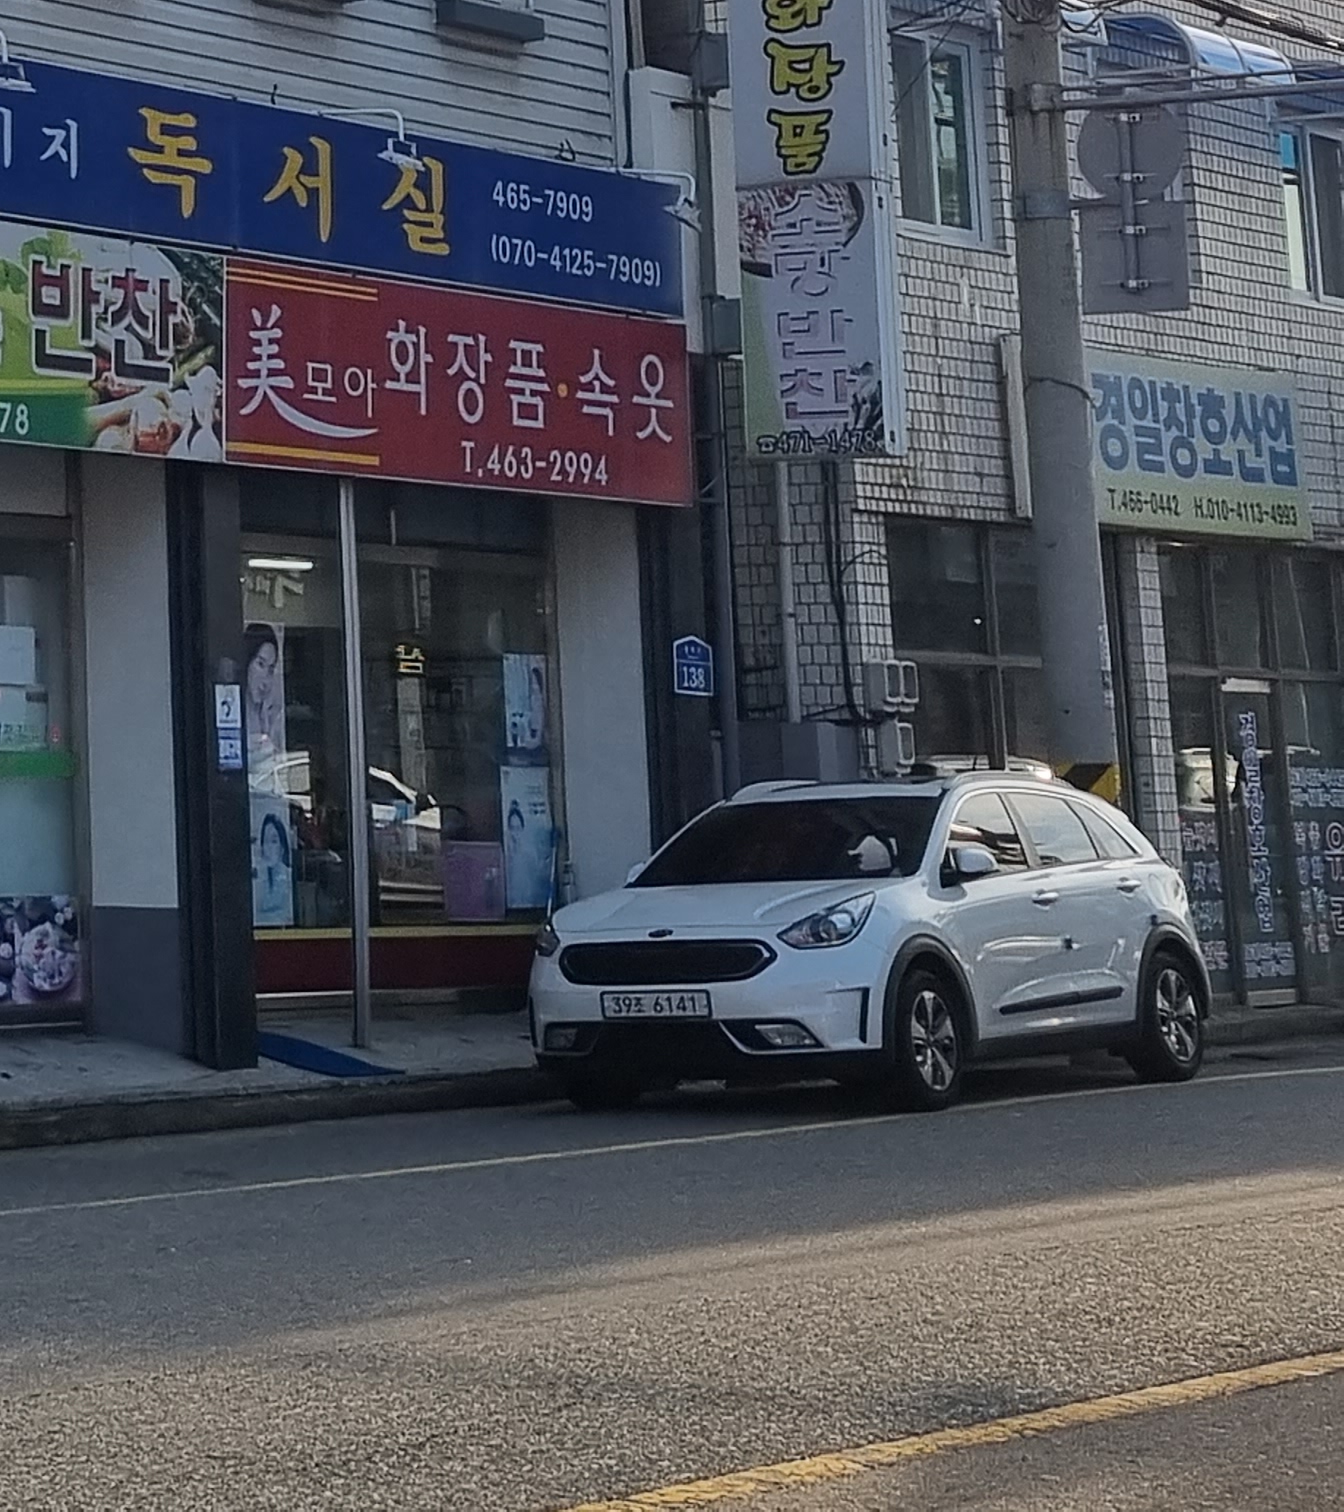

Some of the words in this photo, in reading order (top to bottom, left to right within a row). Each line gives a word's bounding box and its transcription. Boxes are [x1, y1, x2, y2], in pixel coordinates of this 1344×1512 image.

[126, 106, 452, 256] 독서실
[491, 179, 595, 224] 465-7909
[489, 235, 662, 288] (070-4125-7909)
[29, 252, 181, 386] 반찬
[777, 428, 877, 455] 471-1478
[1090, 371, 1299, 488] 경일창호산업
[459, 439, 609, 486] T.463-2994
[682, 665, 706, 689] 138
[652, 994, 698, 1015] 6141
